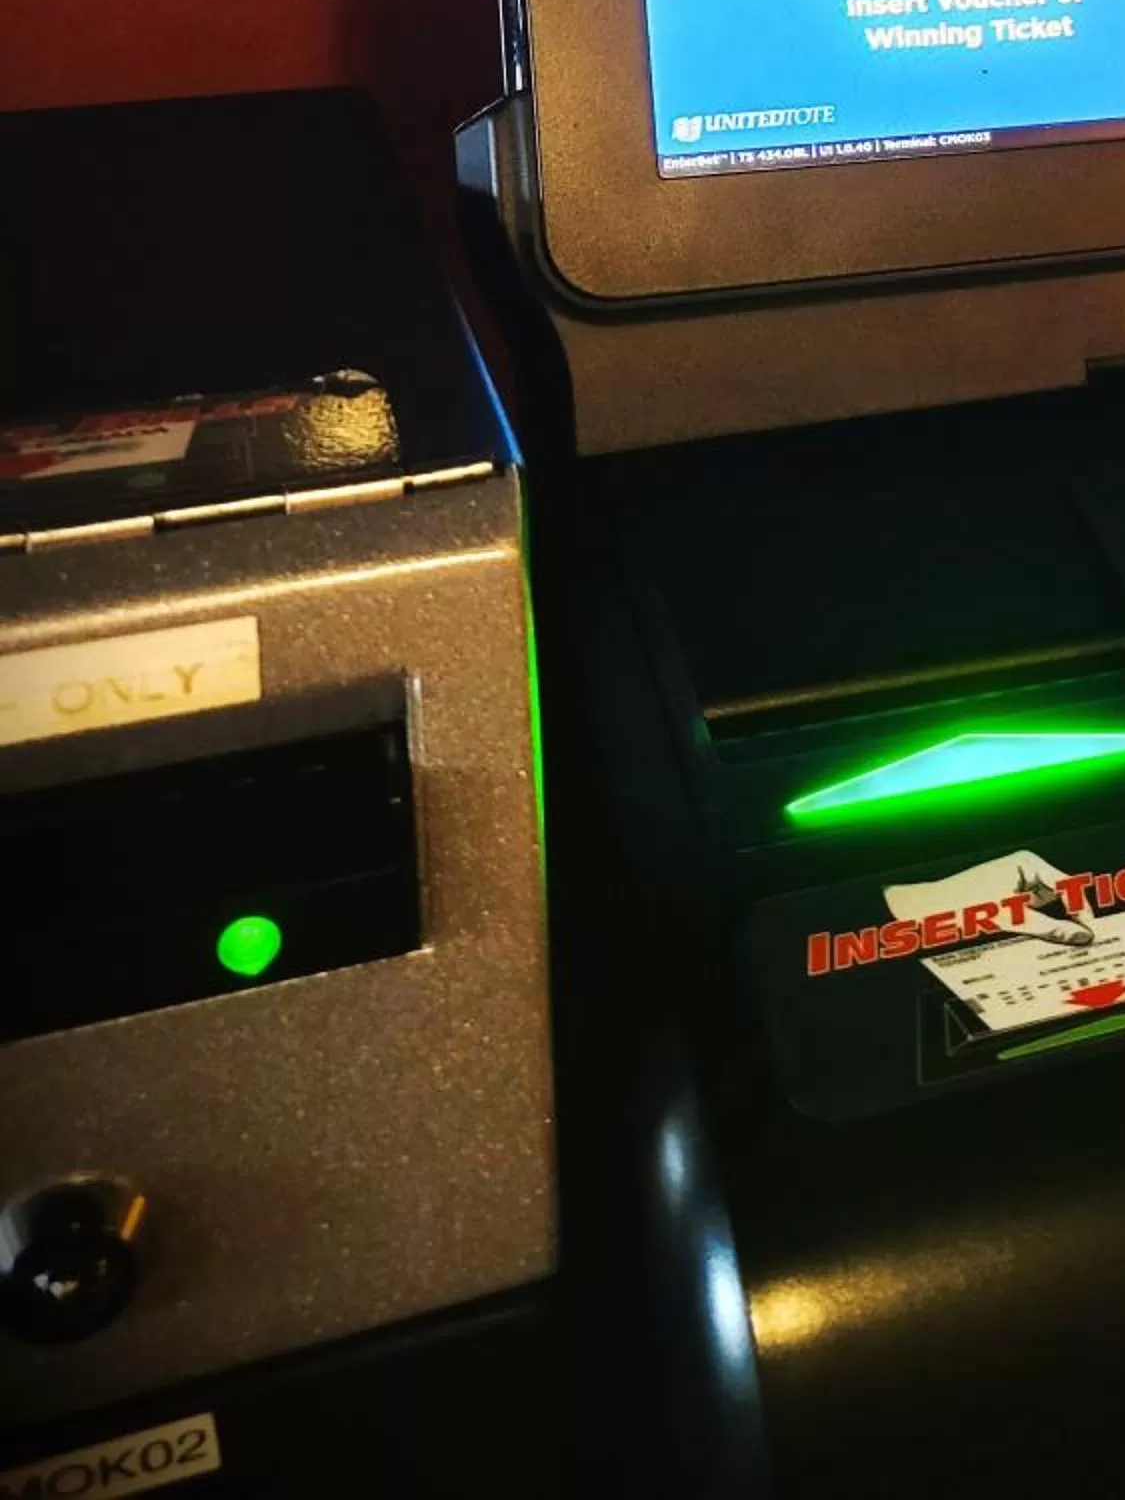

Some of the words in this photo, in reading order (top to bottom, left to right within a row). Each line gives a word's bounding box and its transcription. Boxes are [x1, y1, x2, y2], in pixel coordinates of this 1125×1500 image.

[864, 20, 984, 50] Winning
[990, 15, 1076, 42] Ticket
[51, 661, 205, 716] ONLY
[806, 891, 1034, 977] INSERT
